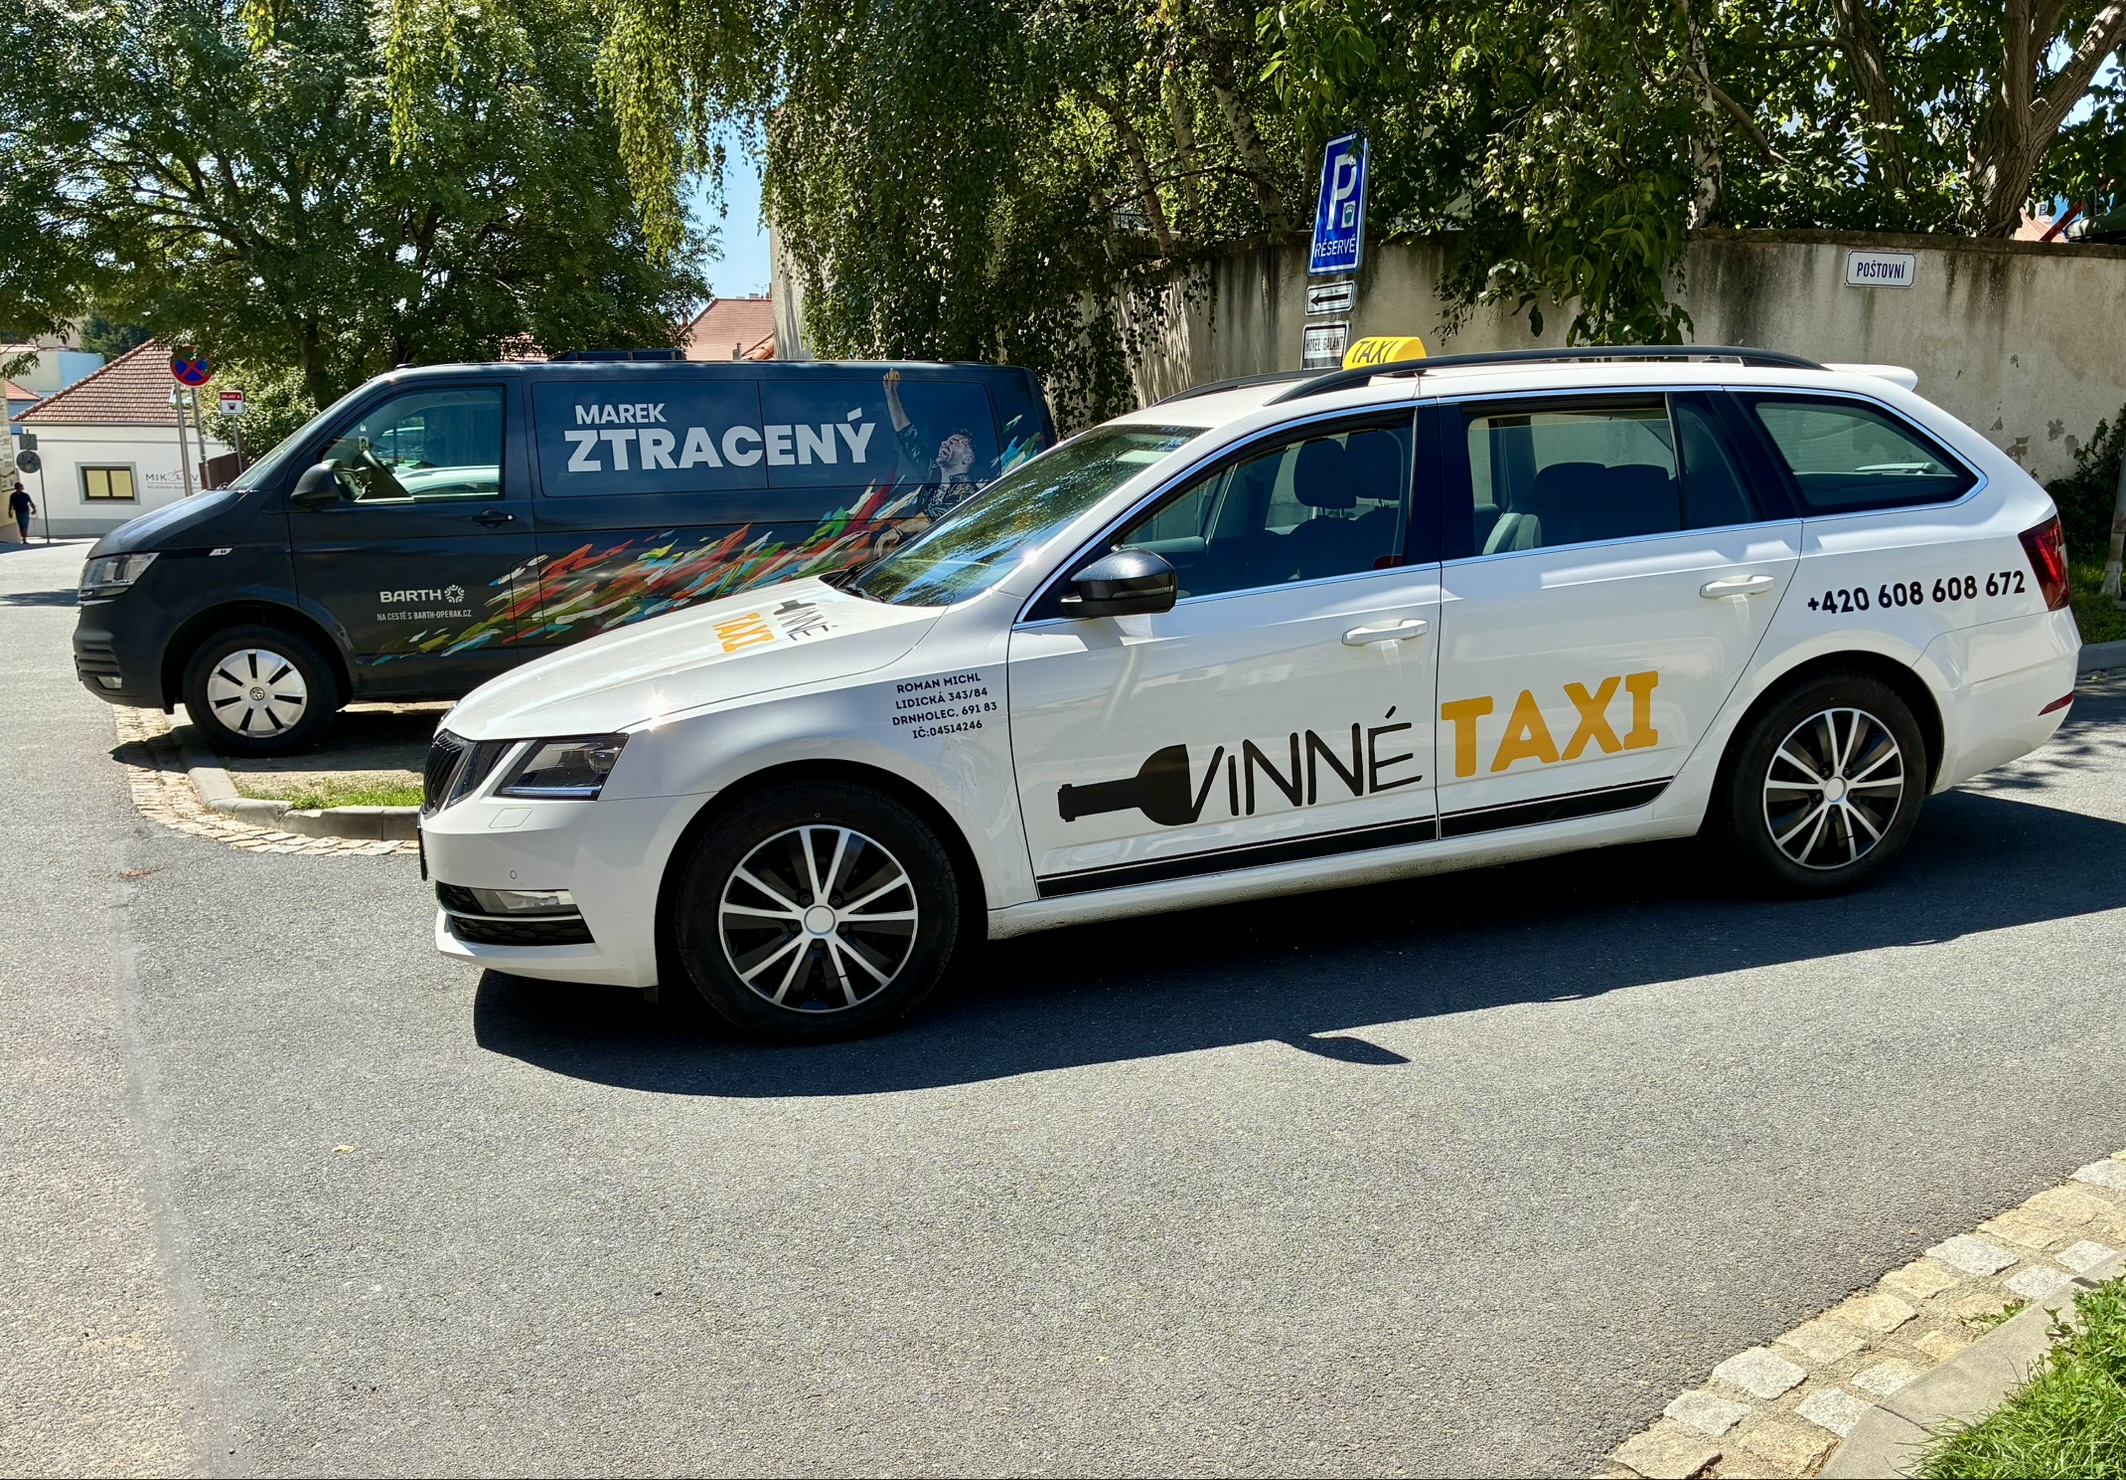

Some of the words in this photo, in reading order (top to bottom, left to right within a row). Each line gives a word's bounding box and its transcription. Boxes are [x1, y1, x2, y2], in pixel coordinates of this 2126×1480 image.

[1314, 234, 1356, 258] RÉSERVÉ
[1856, 260, 1906, 279] POŠTOVNÍ
[1352, 340, 1399, 364] TAXI
[575, 403, 668, 425] MAREK
[564, 407, 876, 473] ZTRACENÝ
[380, 589, 442, 603] BARTH
[1807, 586, 1870, 614] +420
[1877, 580, 1924, 609] 608
[1931, 575, 1978, 603] 608
[1985, 570, 2026, 597] 672
[376, 613, 387, 621] NA
[407, 612, 412, 620] S
[413, 609, 472, 620] BARTH-OPERAK.CZ
[712, 612, 775, 653] TAXI
[896, 678, 940, 694] ROMAN
[943, 672, 982, 687] MICHL
[895, 691, 946, 710] LIDICKÁ
[948, 687, 988, 702] 343/84
[961, 704, 981, 716] 691
[983, 701, 998, 712] 83
[912, 720, 983, 739] IČ:04514246
[1441, 670, 1660, 778] TAXI
